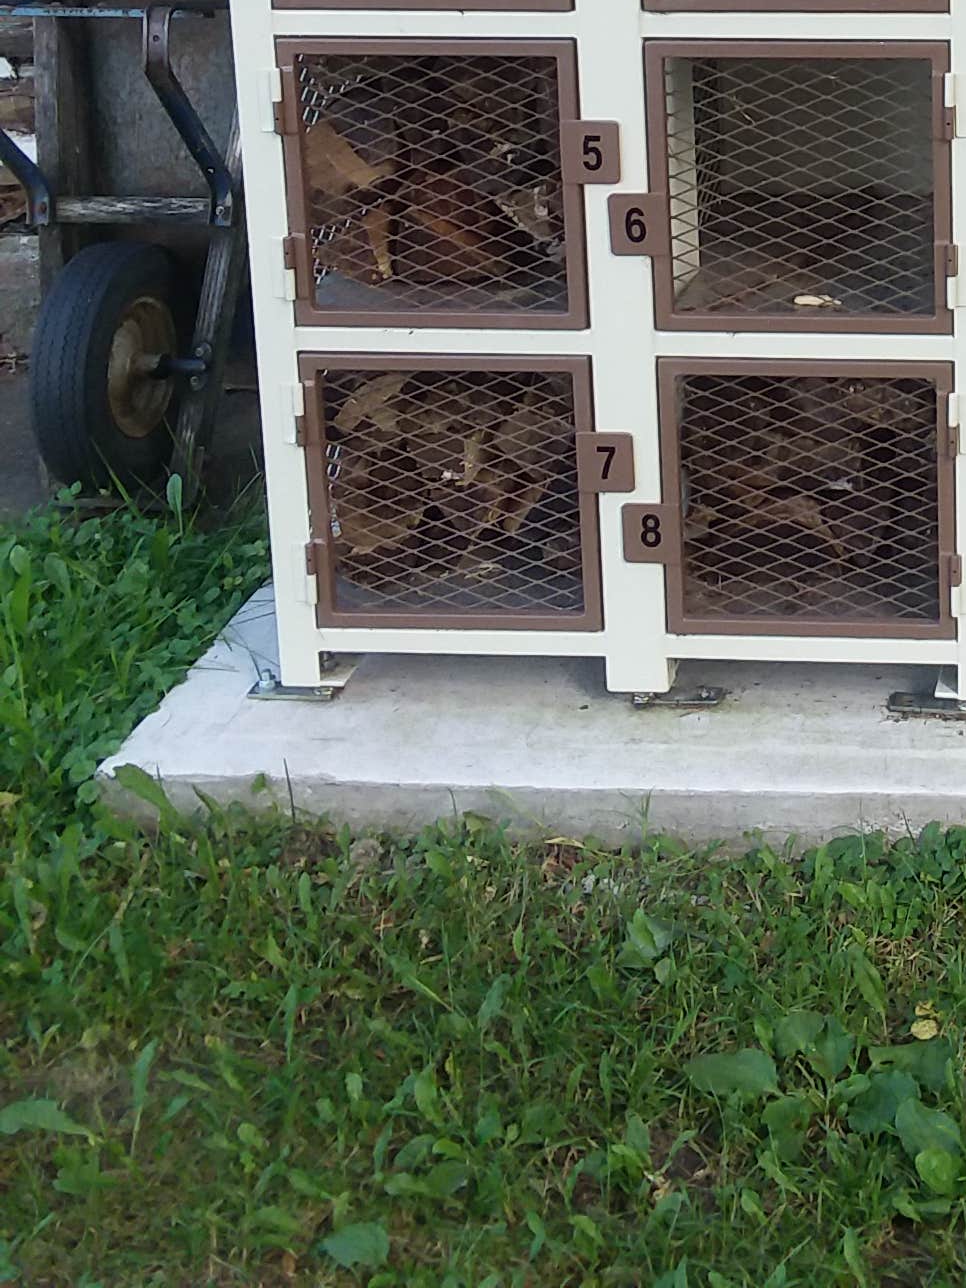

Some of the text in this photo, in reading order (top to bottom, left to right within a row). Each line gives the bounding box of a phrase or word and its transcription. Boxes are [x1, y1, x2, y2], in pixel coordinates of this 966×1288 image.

[582, 135, 603, 171] 5
[625, 207, 646, 243] 6
[596, 446, 616, 480] 7
[641, 514, 661, 547] 8
